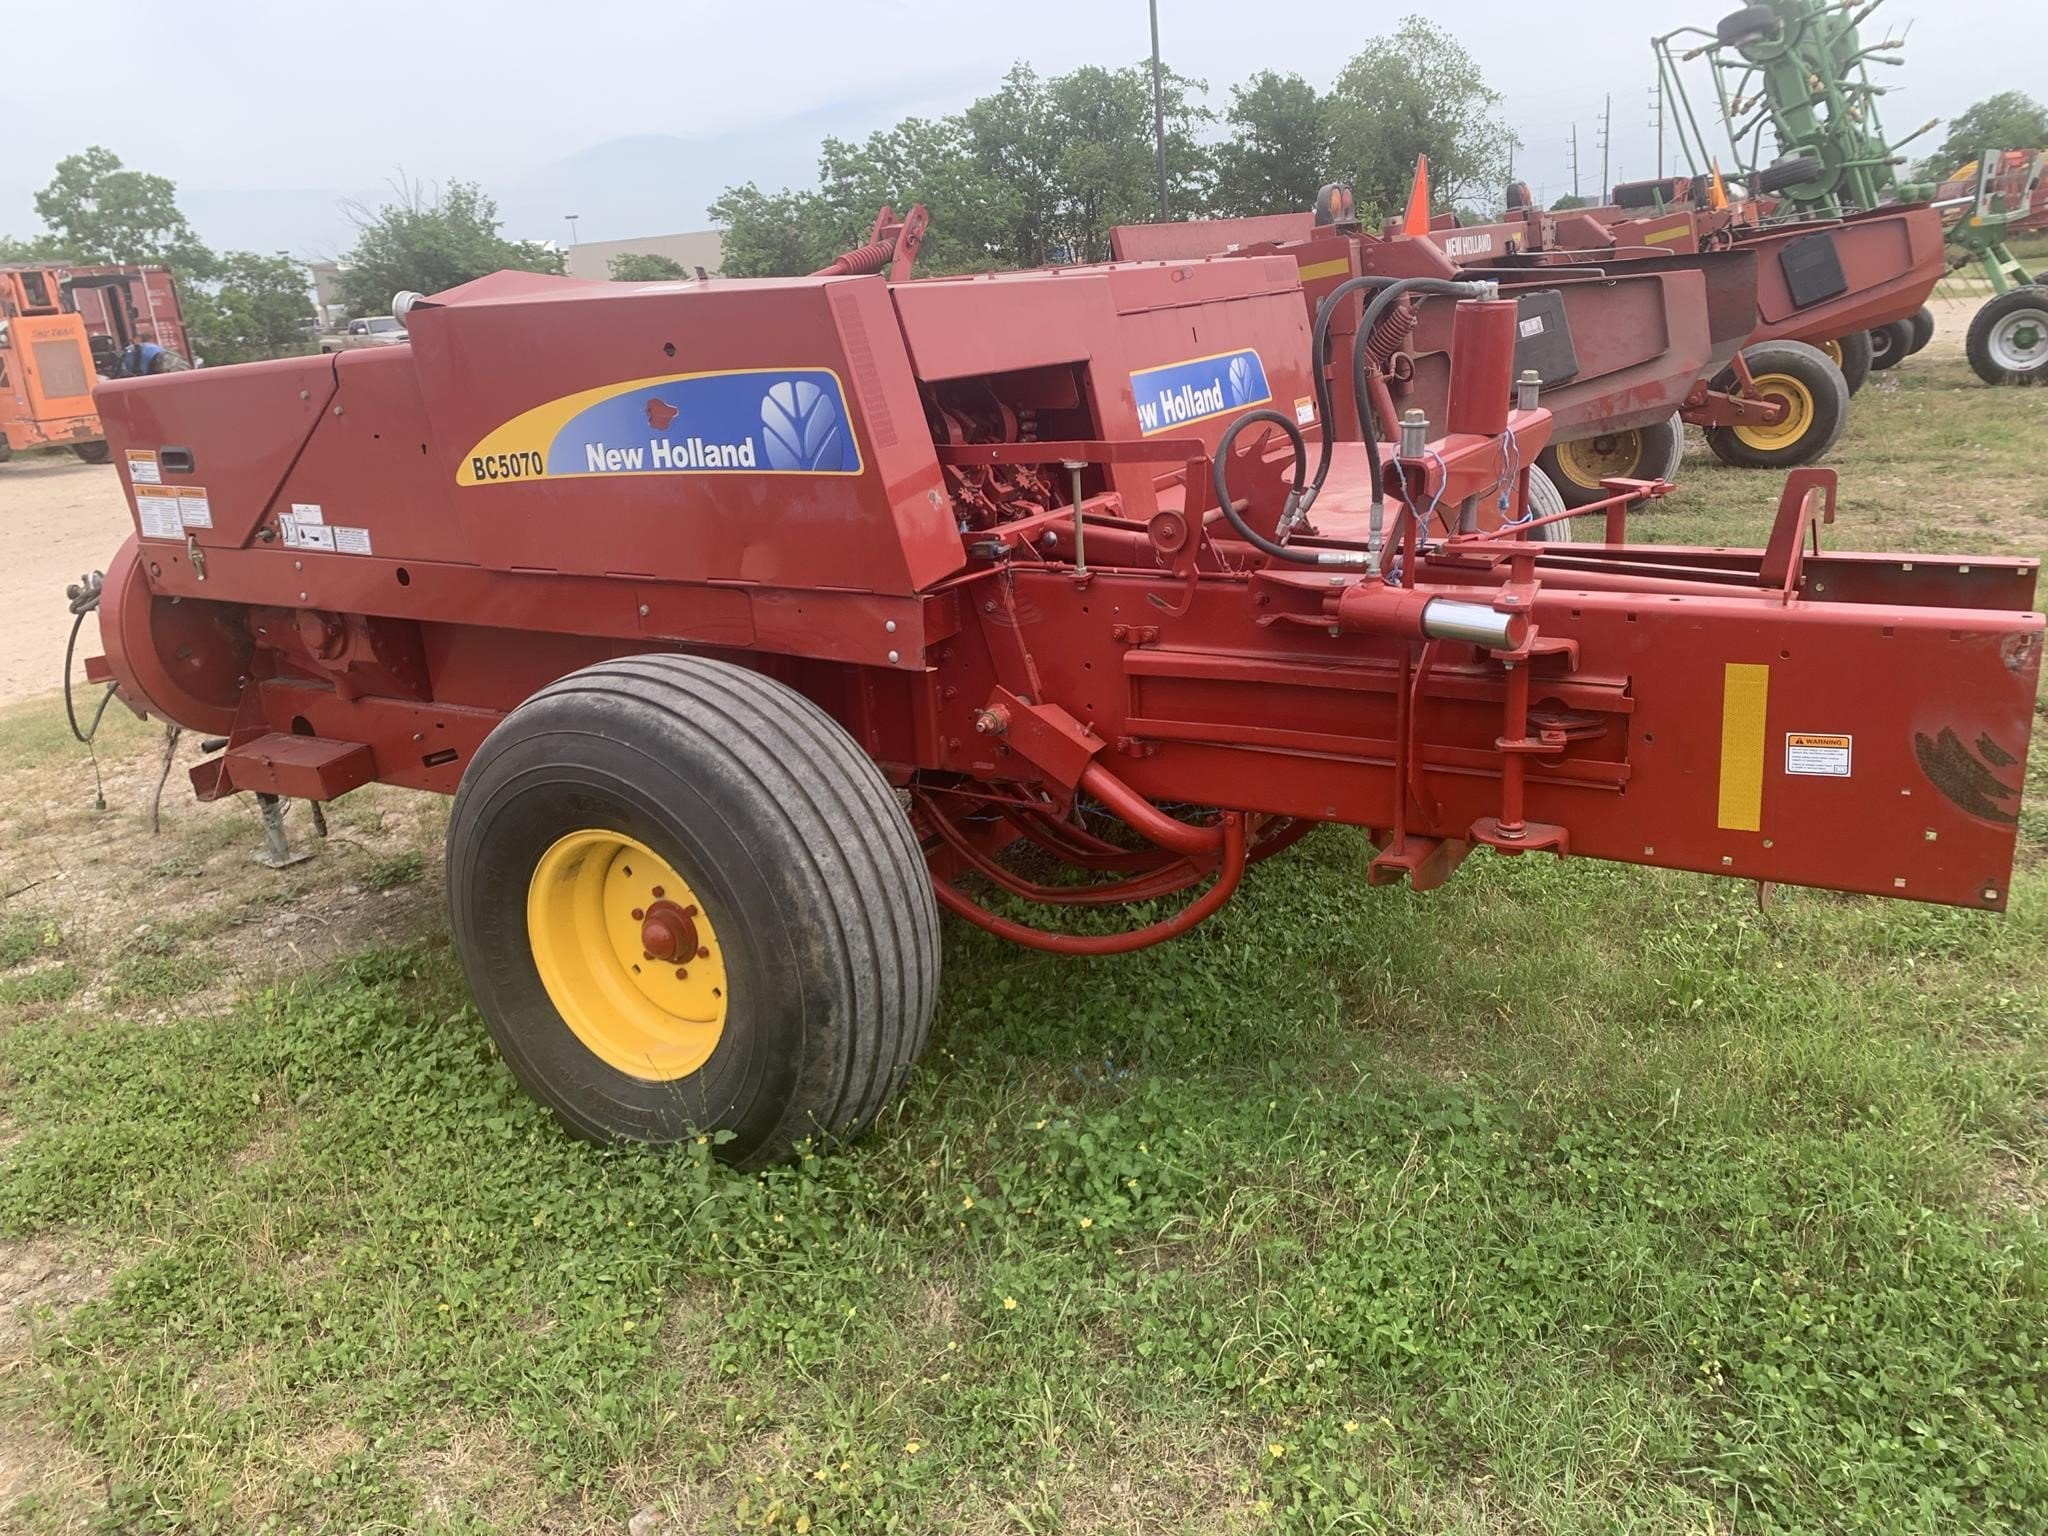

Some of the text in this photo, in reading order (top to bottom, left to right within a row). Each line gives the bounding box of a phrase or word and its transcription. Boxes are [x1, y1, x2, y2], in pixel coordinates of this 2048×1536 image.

[1446, 233, 1492, 257] NEW HOLLAND
[1159, 377, 1224, 424] Holland
[472, 451, 544, 480] BC5070
[584, 437, 757, 472] New Holland
[1806, 738, 1843, 746] WARNING
